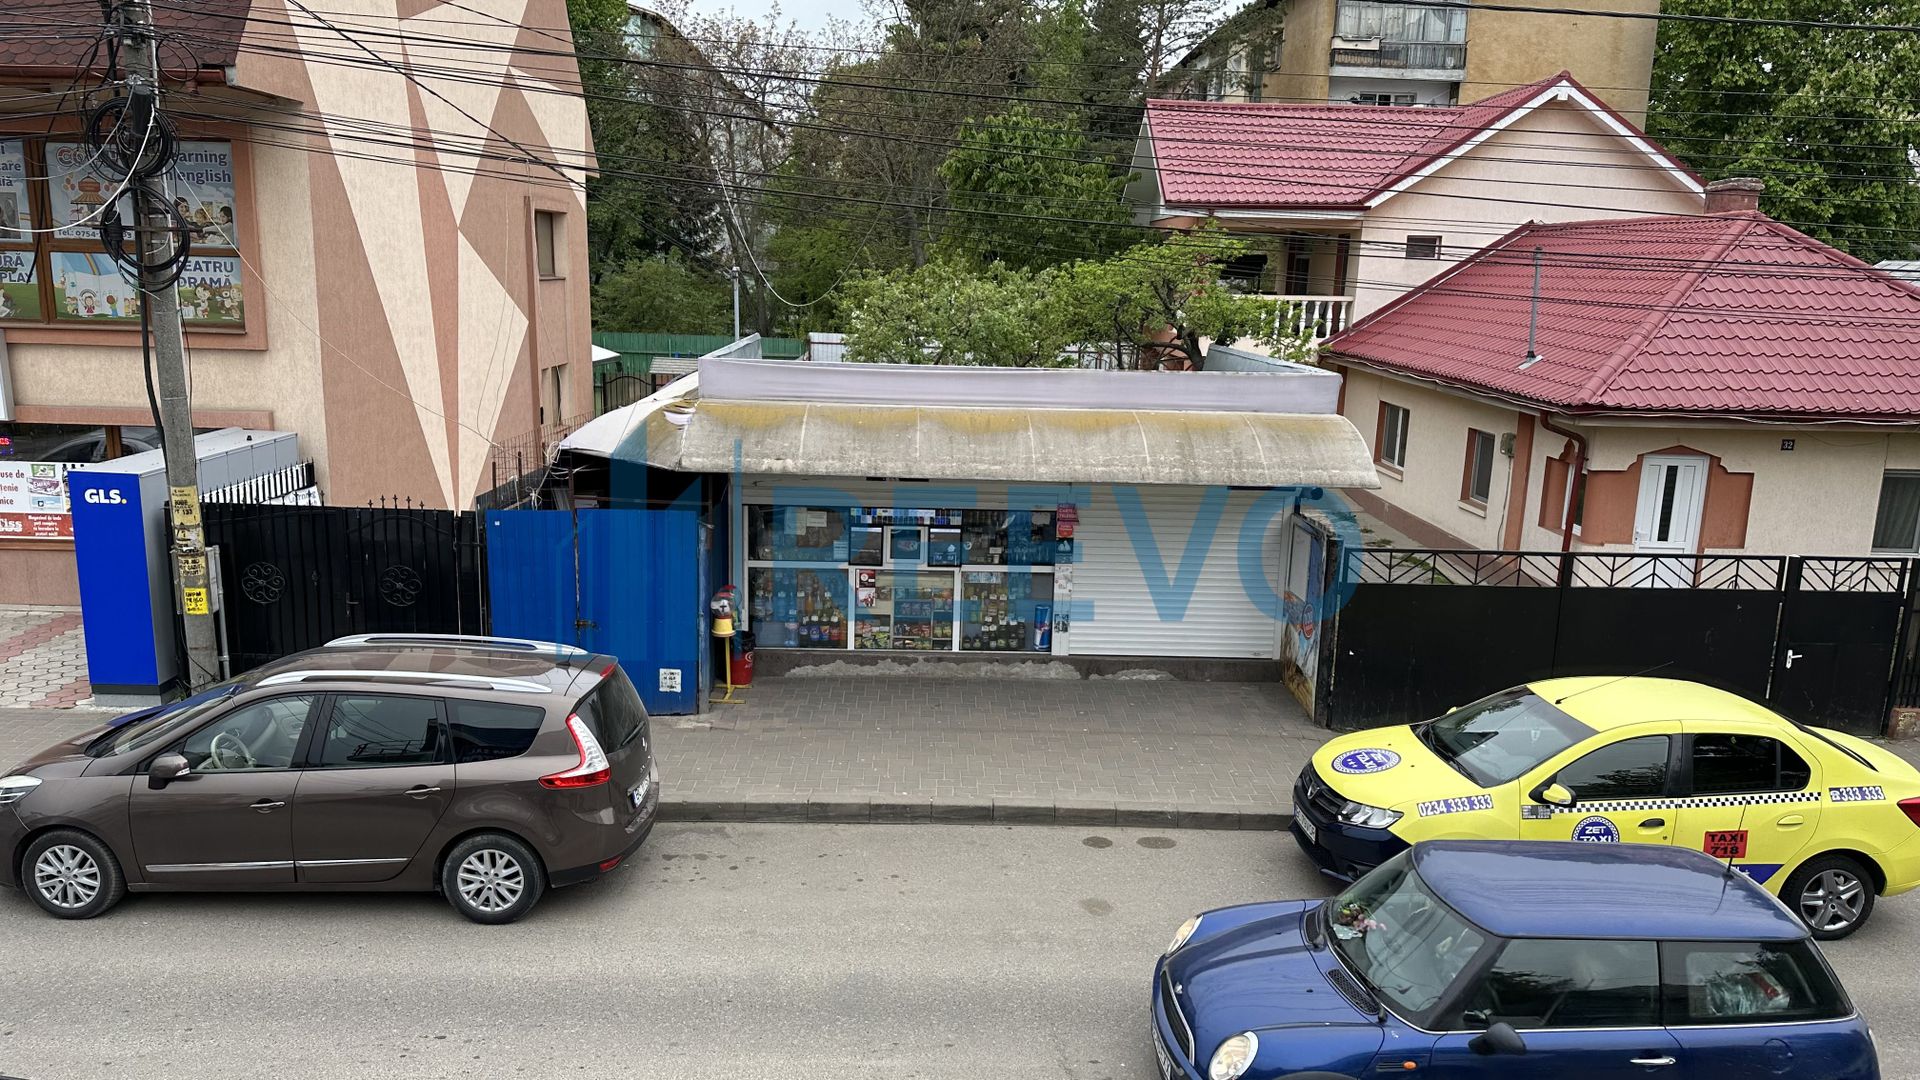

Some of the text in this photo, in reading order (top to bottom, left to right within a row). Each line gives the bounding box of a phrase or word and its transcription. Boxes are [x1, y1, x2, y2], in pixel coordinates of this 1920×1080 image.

[178, 150, 228, 167] arning
[177, 169, 232, 185] english
[1782, 440, 1793, 450] 32
[1863, 786, 1885, 801] 333
[1418, 794, 1493, 817] 0234 333 333
[1585, 826, 1607, 834] ZET
[1709, 833, 1745, 843] TAXI
[1710, 846, 1739, 856] 718
